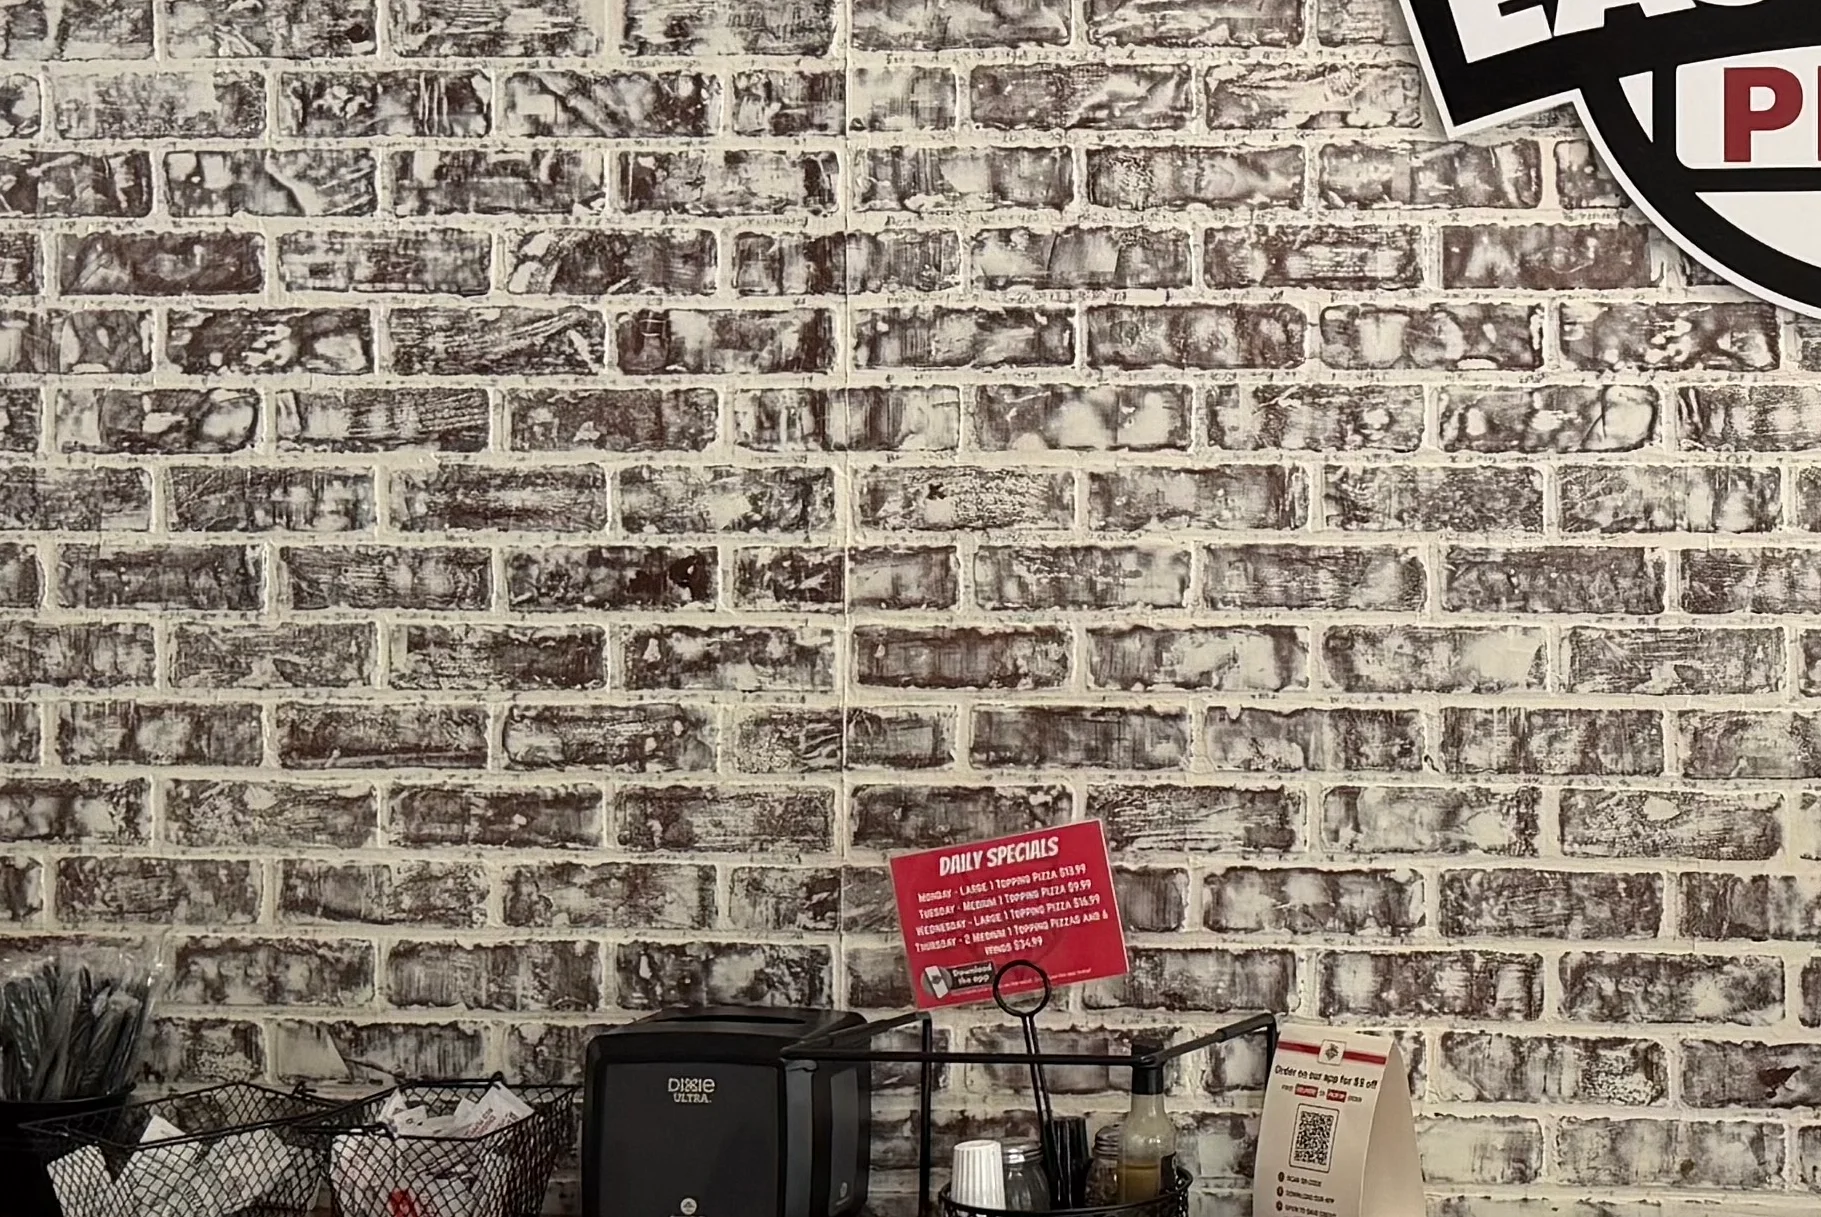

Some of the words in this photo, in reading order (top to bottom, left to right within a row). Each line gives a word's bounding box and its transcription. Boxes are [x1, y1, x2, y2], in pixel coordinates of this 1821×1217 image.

[939, 850, 983, 877] DAILY
[987, 836, 1059, 868] SPECIALS
[1032, 870, 1058, 882] PIZZA
[1041, 884, 1066, 897] PIZZA
[1046, 901, 1072, 913] PIZZA
[1050, 914, 1080, 928] PIZZAS
[952, 962, 993, 977] Download
[1275, 1064, 1297, 1077] Order
[1366, 1079, 1378, 1089] off
